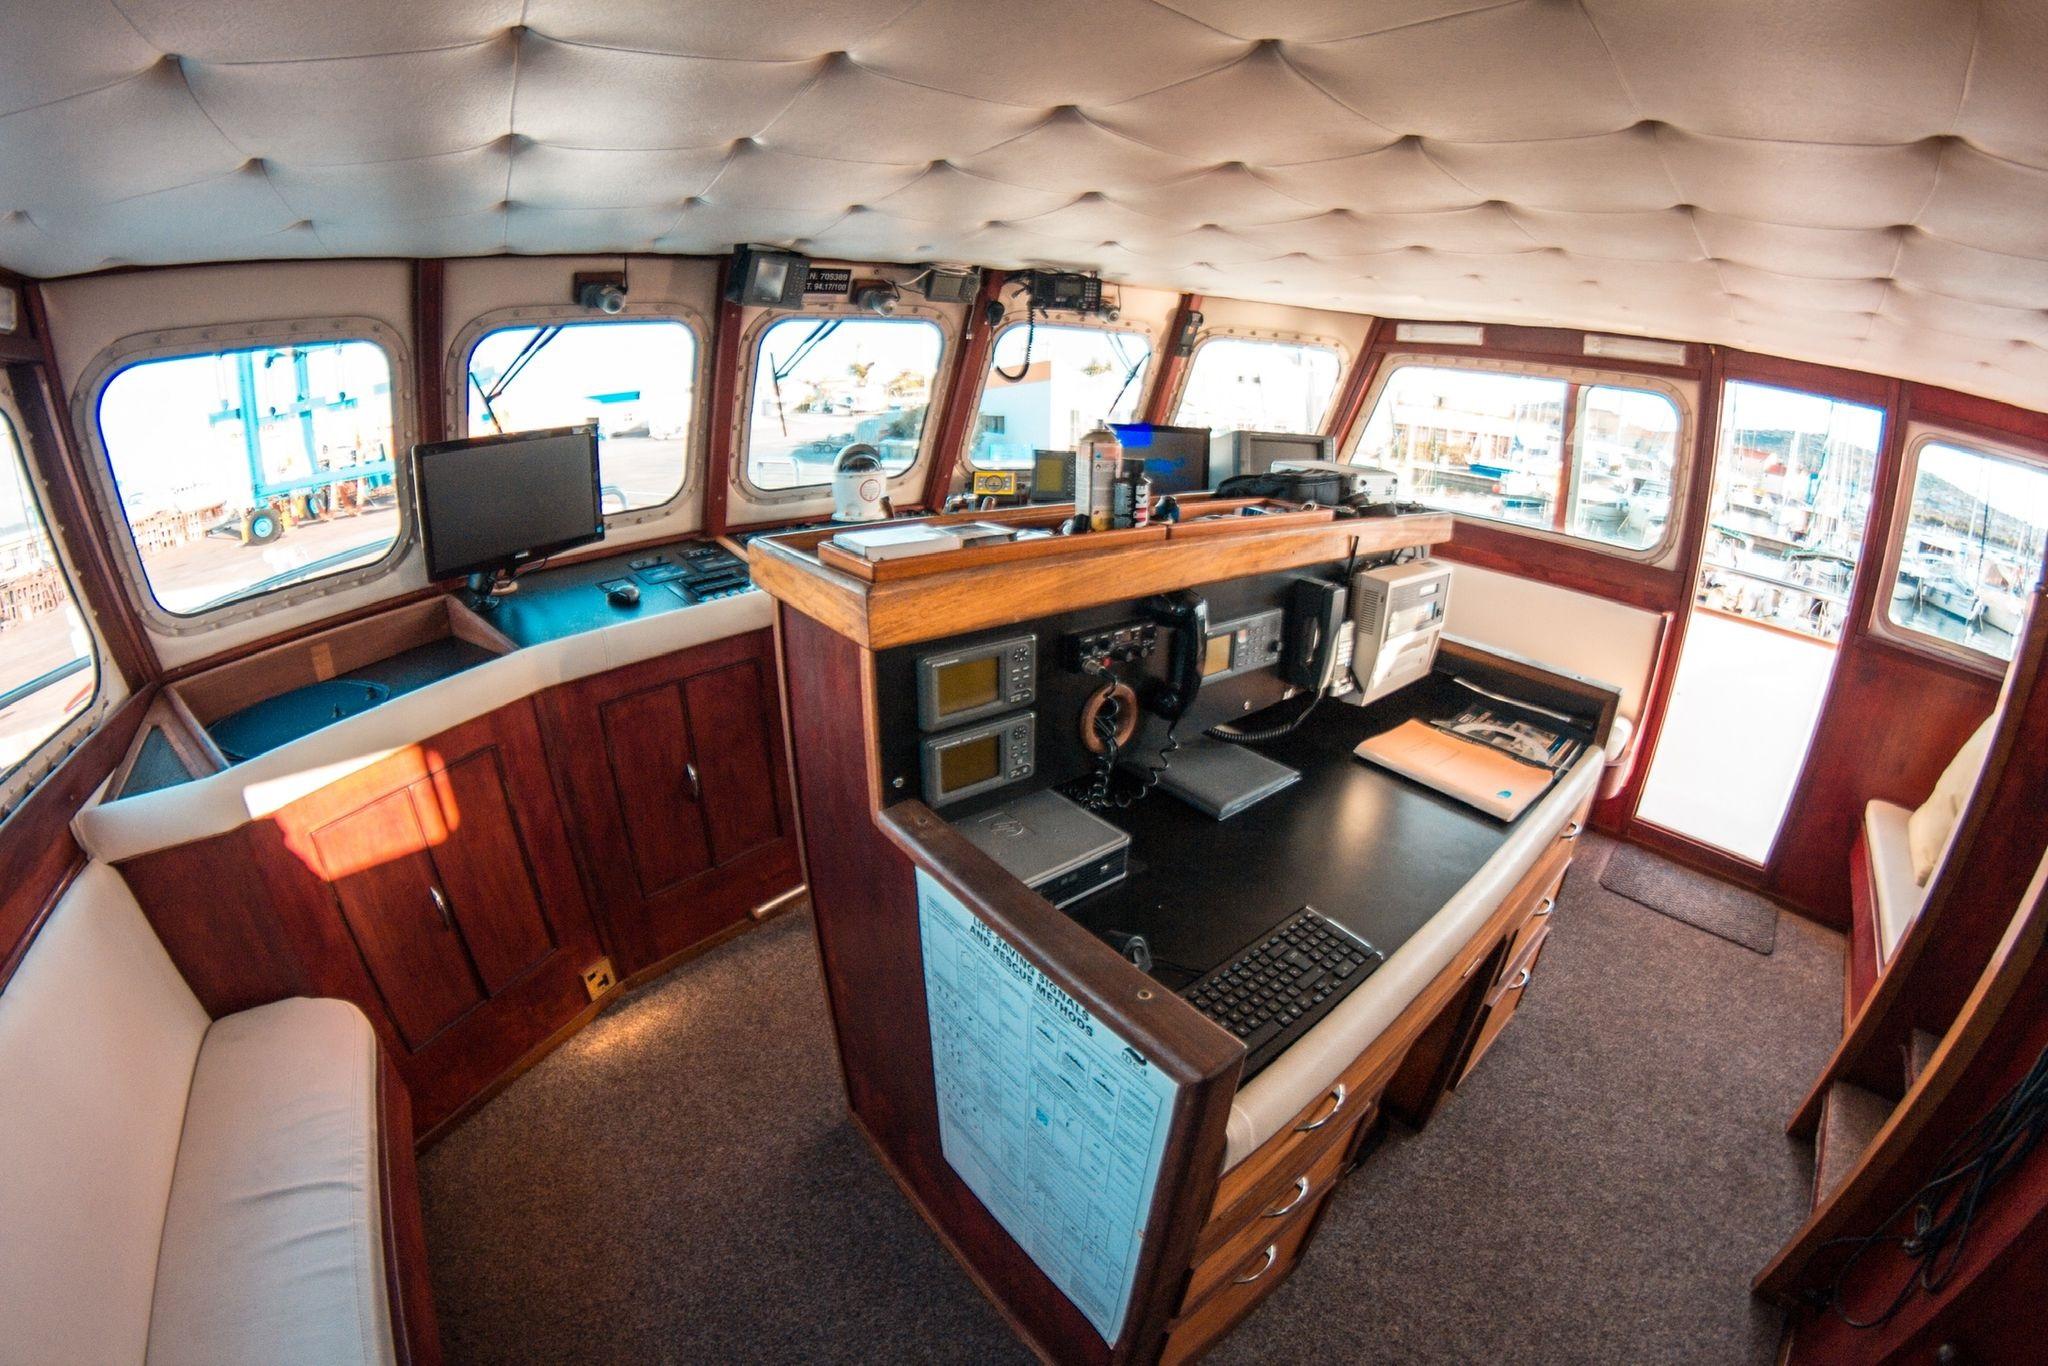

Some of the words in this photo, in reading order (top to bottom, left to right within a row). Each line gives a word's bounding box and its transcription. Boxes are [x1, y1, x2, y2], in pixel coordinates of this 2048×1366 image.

[970, 926, 990, 947] AND
[992, 946, 1034, 986] RESCUE
[1036, 983, 1093, 1037] METHODS
[973, 916, 1035, 975] LIFE-SAVING
[1038, 973, 1089, 1021] SIGNALS
